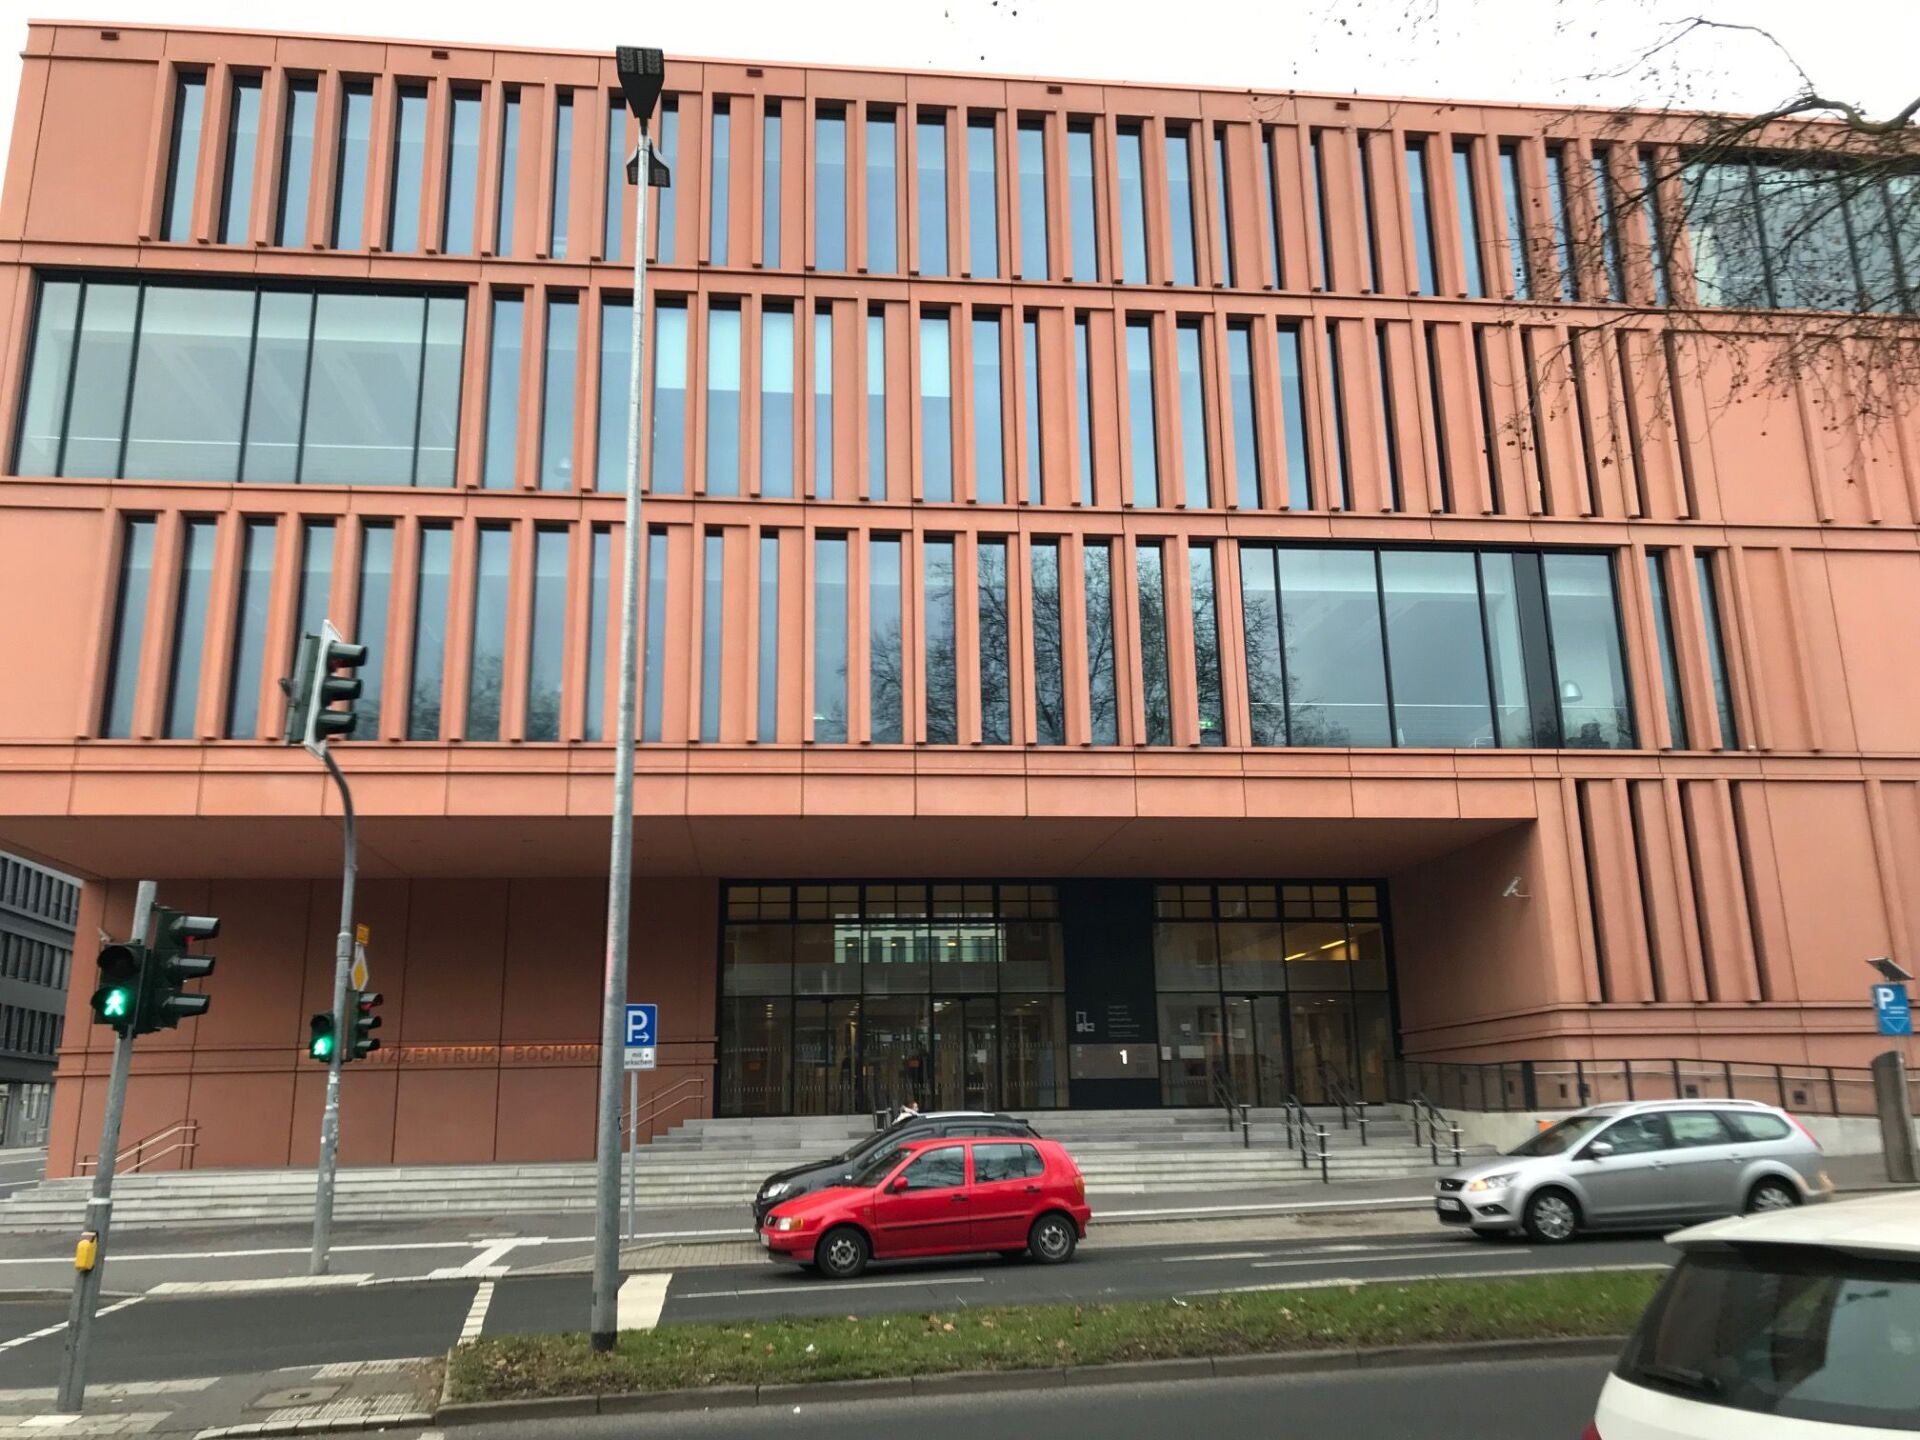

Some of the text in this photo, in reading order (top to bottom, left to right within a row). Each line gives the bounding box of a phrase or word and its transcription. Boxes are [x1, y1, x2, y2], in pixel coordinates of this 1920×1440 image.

[1878, 987, 1895, 1010] P
[627, 1010, 648, 1043] P
[513, 1045, 596, 1062] BOCHUM
[1119, 1049, 1128, 1065] 1
